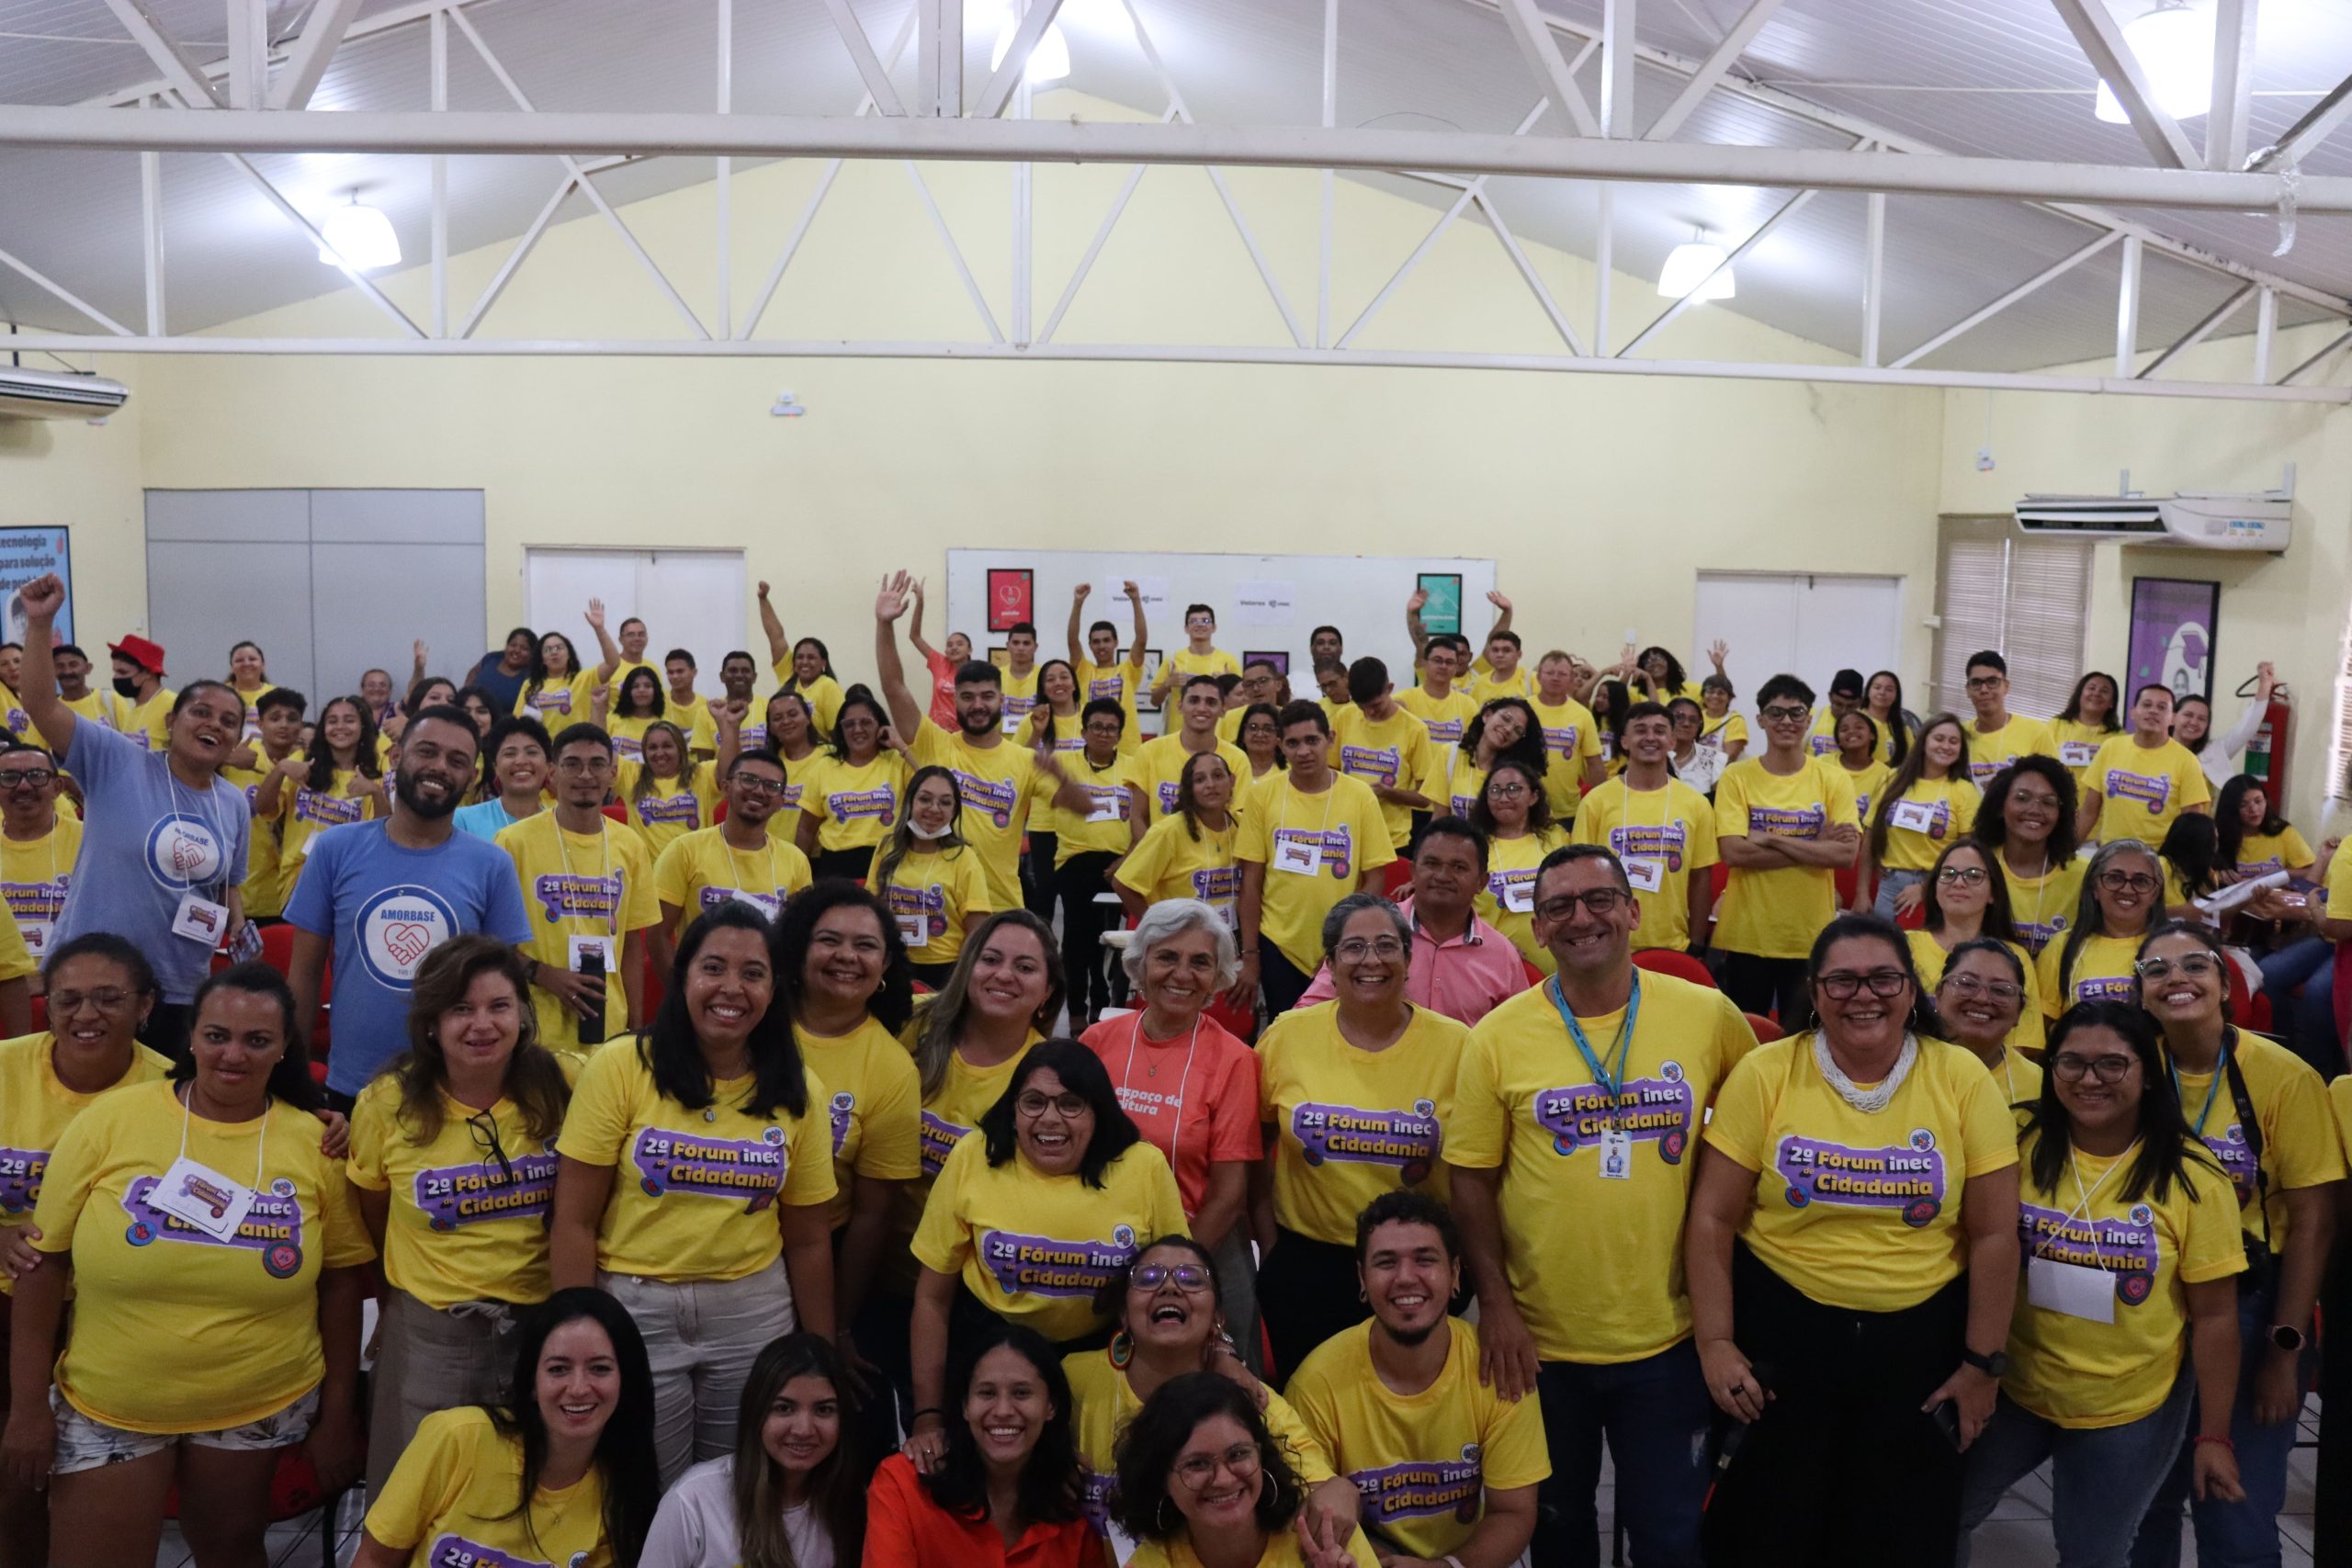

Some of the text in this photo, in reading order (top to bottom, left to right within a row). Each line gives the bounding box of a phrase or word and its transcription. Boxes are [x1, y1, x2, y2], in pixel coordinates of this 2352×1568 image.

[0, 554, 55, 572] para solução
[1378, 753, 1396, 764] inec
[962, 778, 992, 795] Fórum
[992, 785, 1012, 798] inec
[2148, 778, 2165, 790] inec
[842, 793, 871, 804] Fórum
[872, 791, 891, 800] inec
[961, 790, 1009, 809] Cidadania
[1765, 812, 1800, 823] Fórum
[1800, 814, 1820, 824] inec
[1291, 834, 1325, 844] Fórum
[1327, 835, 1347, 845] inec
[1629, 829, 1661, 840] Fórum
[1661, 830, 1682, 841] inec
[1630, 842, 1681, 852] Cidadania
[3, 887, 39, 898] órum
[544, 881, 618, 894] 2º Fórum ine
[706, 892, 720, 903] 2º
[380, 909, 435, 922] AMORBASE
[2085, 982, 2132, 995] 2º Fór
[1114, 1087, 1182, 1108] espaço de
[1547, 1097, 1570, 1115] 2º
[1643, 1087, 1683, 1103] inec
[1303, 1111, 1431, 1134] 2º Fórum inec
[921, 1122, 961, 1145] órum
[645, 1137, 780, 1164] 2º Fórum inec
[1329, 1134, 1429, 1157] Cidadania
[2211, 1148, 2245, 1162] nec
[0, 1158, 26, 1175] 2º
[657, 1158, 669, 1168] de
[1791, 1145, 1932, 1171] 2º Fórum inec
[427, 1178, 451, 1195] 2º
[526, 1162, 559, 1180] ine
[671, 1165, 778, 1189] Cidadania
[1804, 1167, 1815, 1175] de
[1817, 1172, 1933, 1196] Cidadania
[459, 1187, 551, 1215] Cidadan
[2036, 1216, 2102, 1243] Fórum
[2106, 1227, 2146, 1246] inec
[993, 1240, 1132, 1268] 2º Fórum inec
[2035, 1240, 2147, 1270] Cidadania
[1019, 1268, 1107, 1288] Cidadan
[1358, 1465, 1480, 1495] 2º Fórum inec
[444, 1547, 472, 1568] 2º
